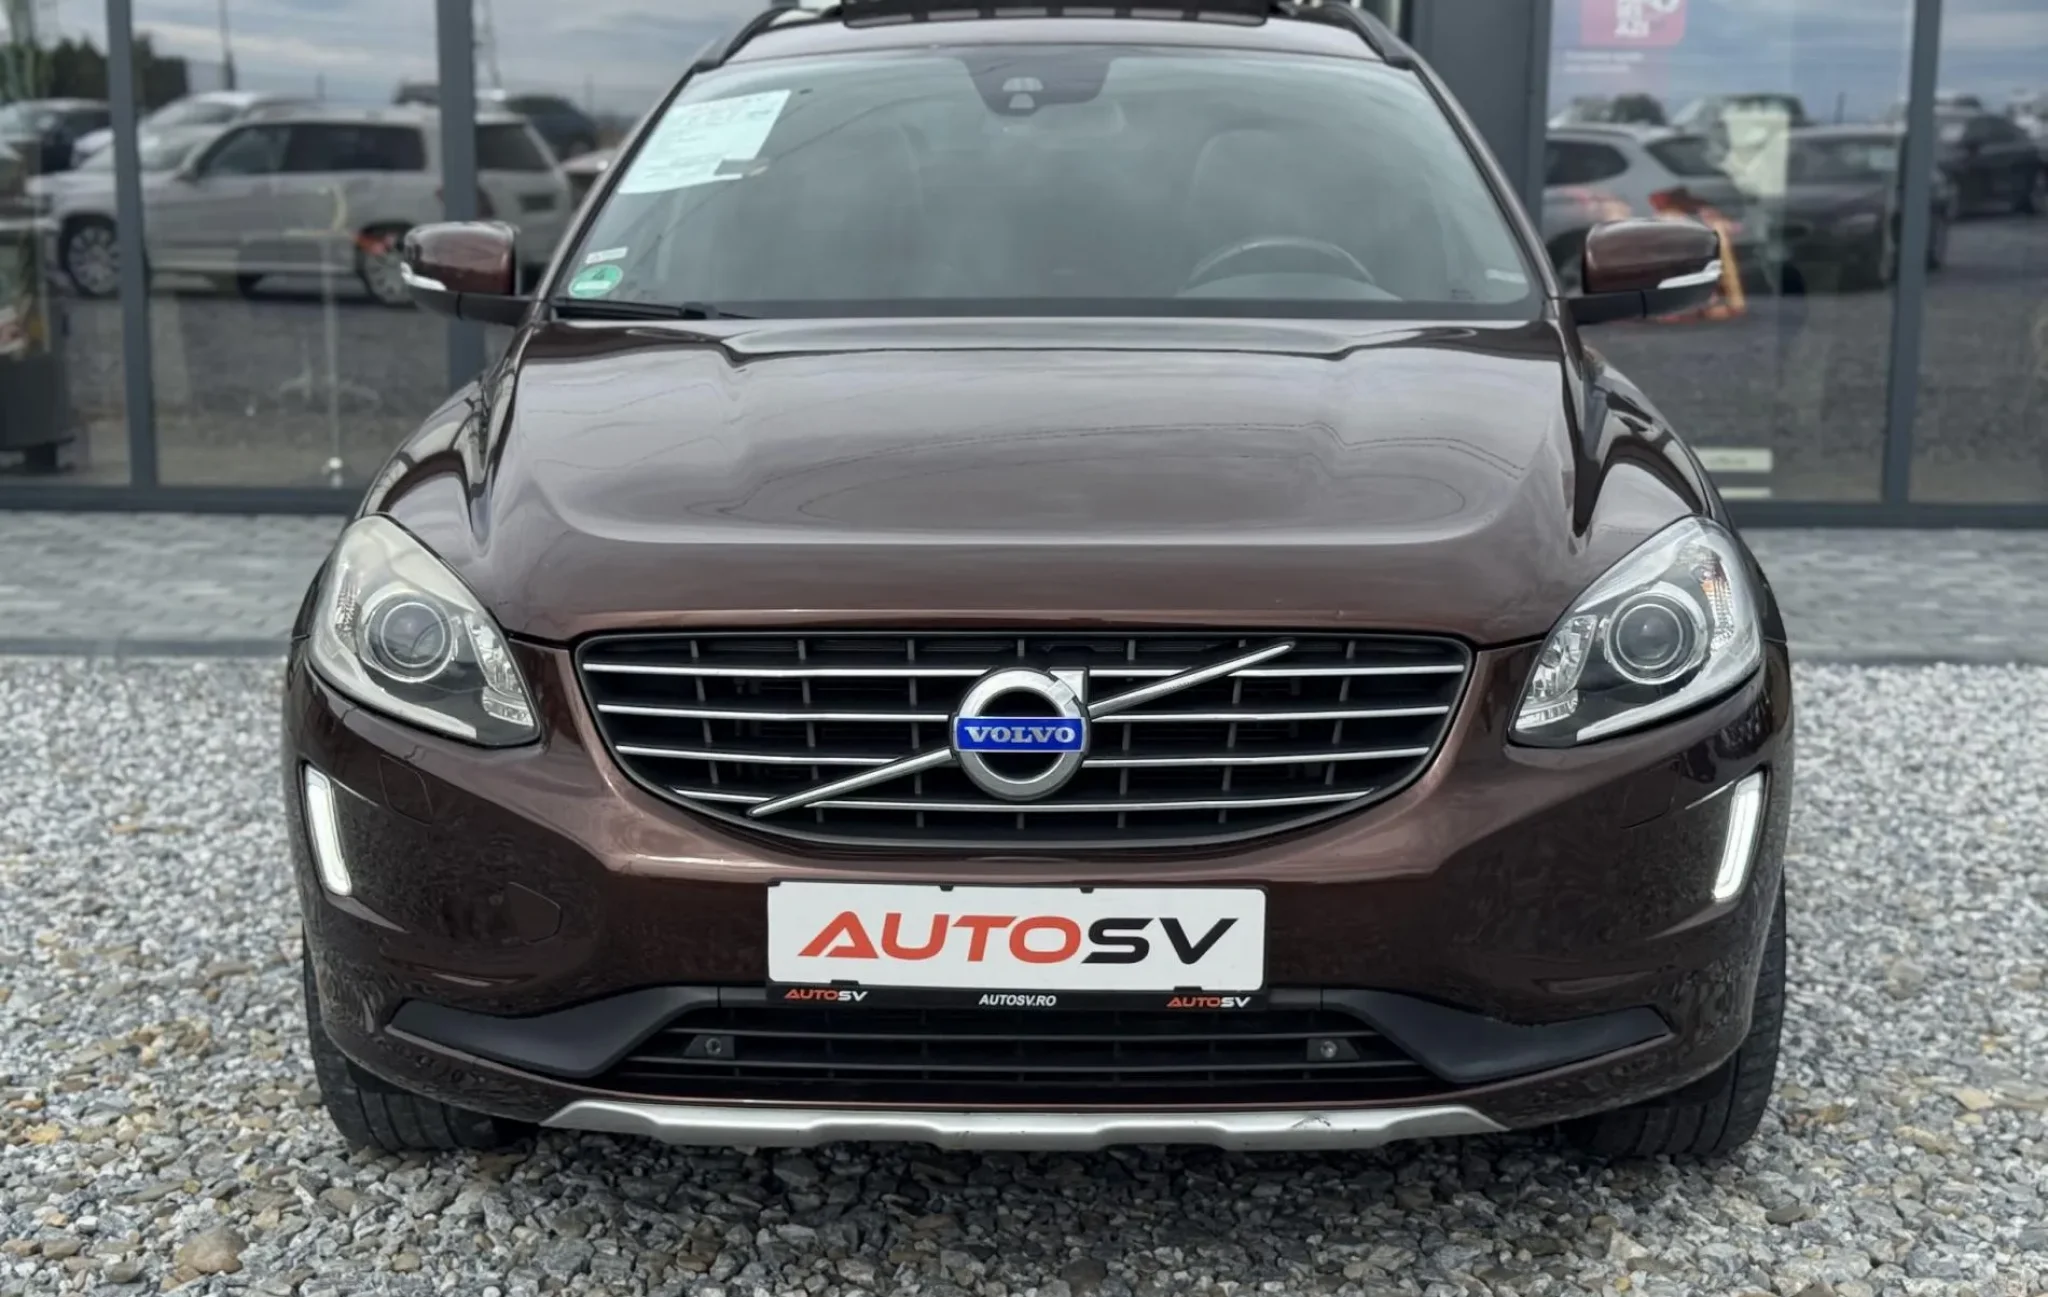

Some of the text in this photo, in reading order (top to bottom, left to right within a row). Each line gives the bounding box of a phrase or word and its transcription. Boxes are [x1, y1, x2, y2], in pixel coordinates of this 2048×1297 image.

[964, 726, 1076, 744] VOLVO
[797, 910, 1239, 966] AUTOSV
[784, 989, 869, 1002] AUTOSV
[978, 994, 1057, 1007] AUTOSV.RO
[1166, 996, 1251, 1008] AUTOSV
